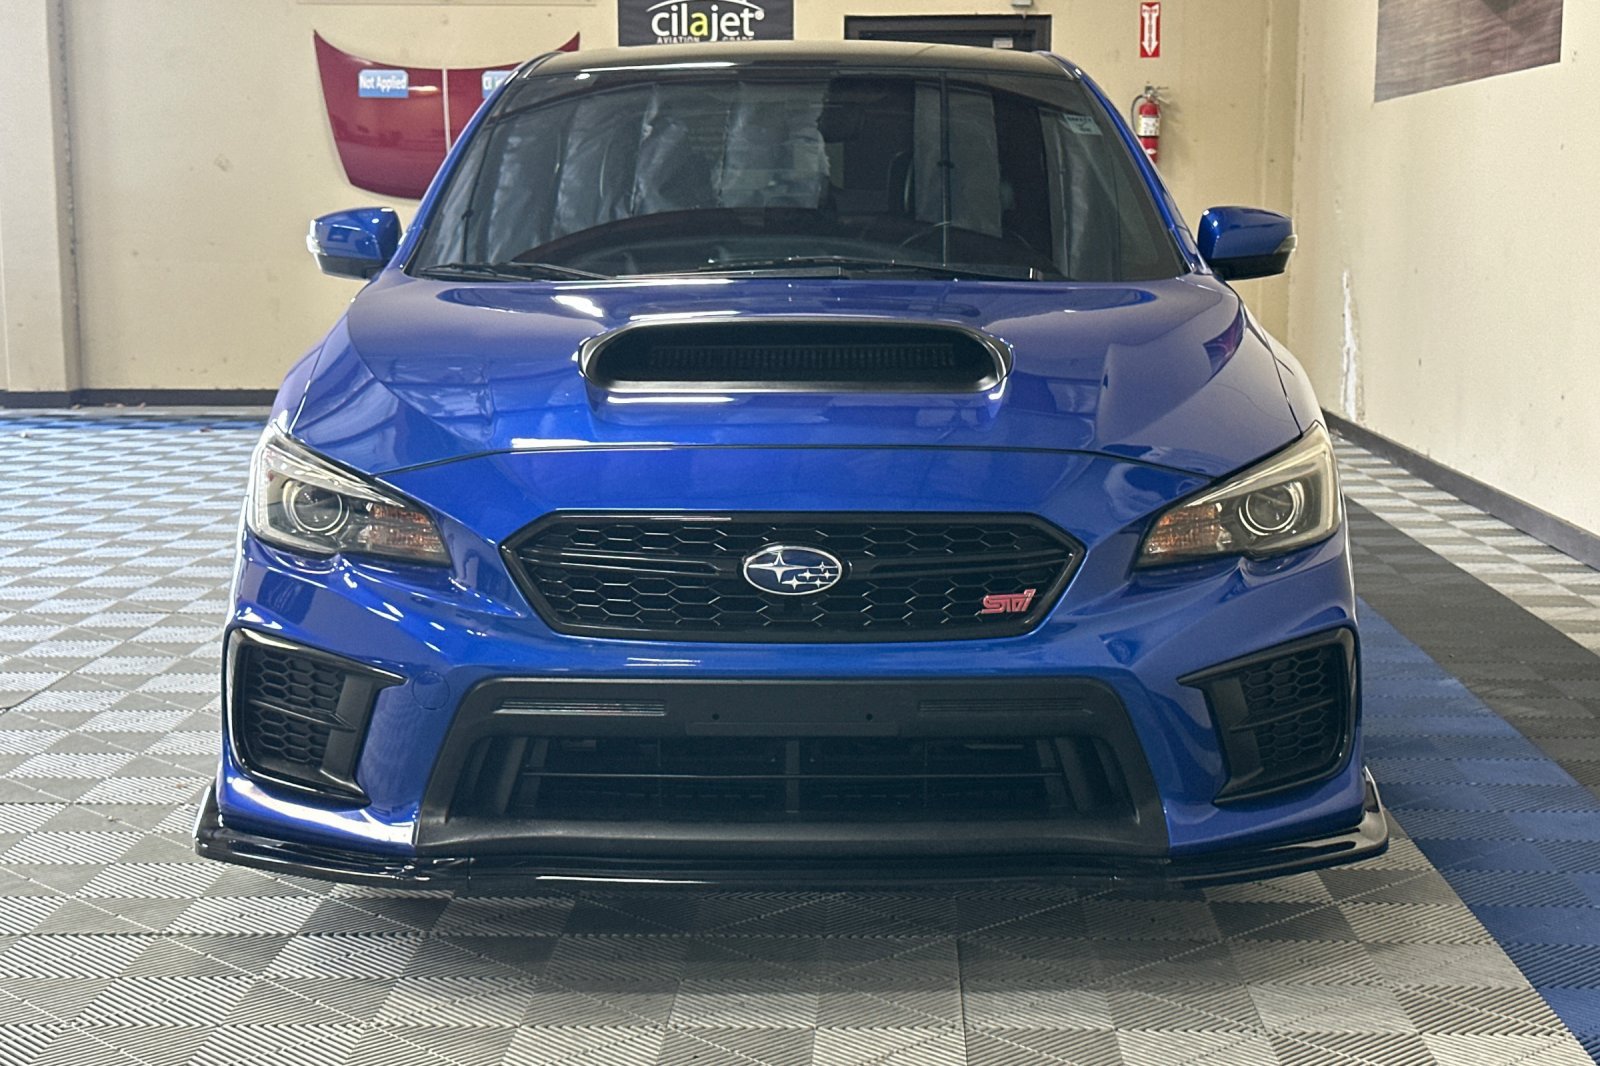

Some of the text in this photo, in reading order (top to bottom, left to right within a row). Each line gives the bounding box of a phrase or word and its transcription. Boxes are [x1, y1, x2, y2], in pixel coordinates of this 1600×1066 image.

[651, 3, 755, 42] cilajet
[656, 36, 700, 44] AVIATION
[359, 75, 407, 93] Not Applied
